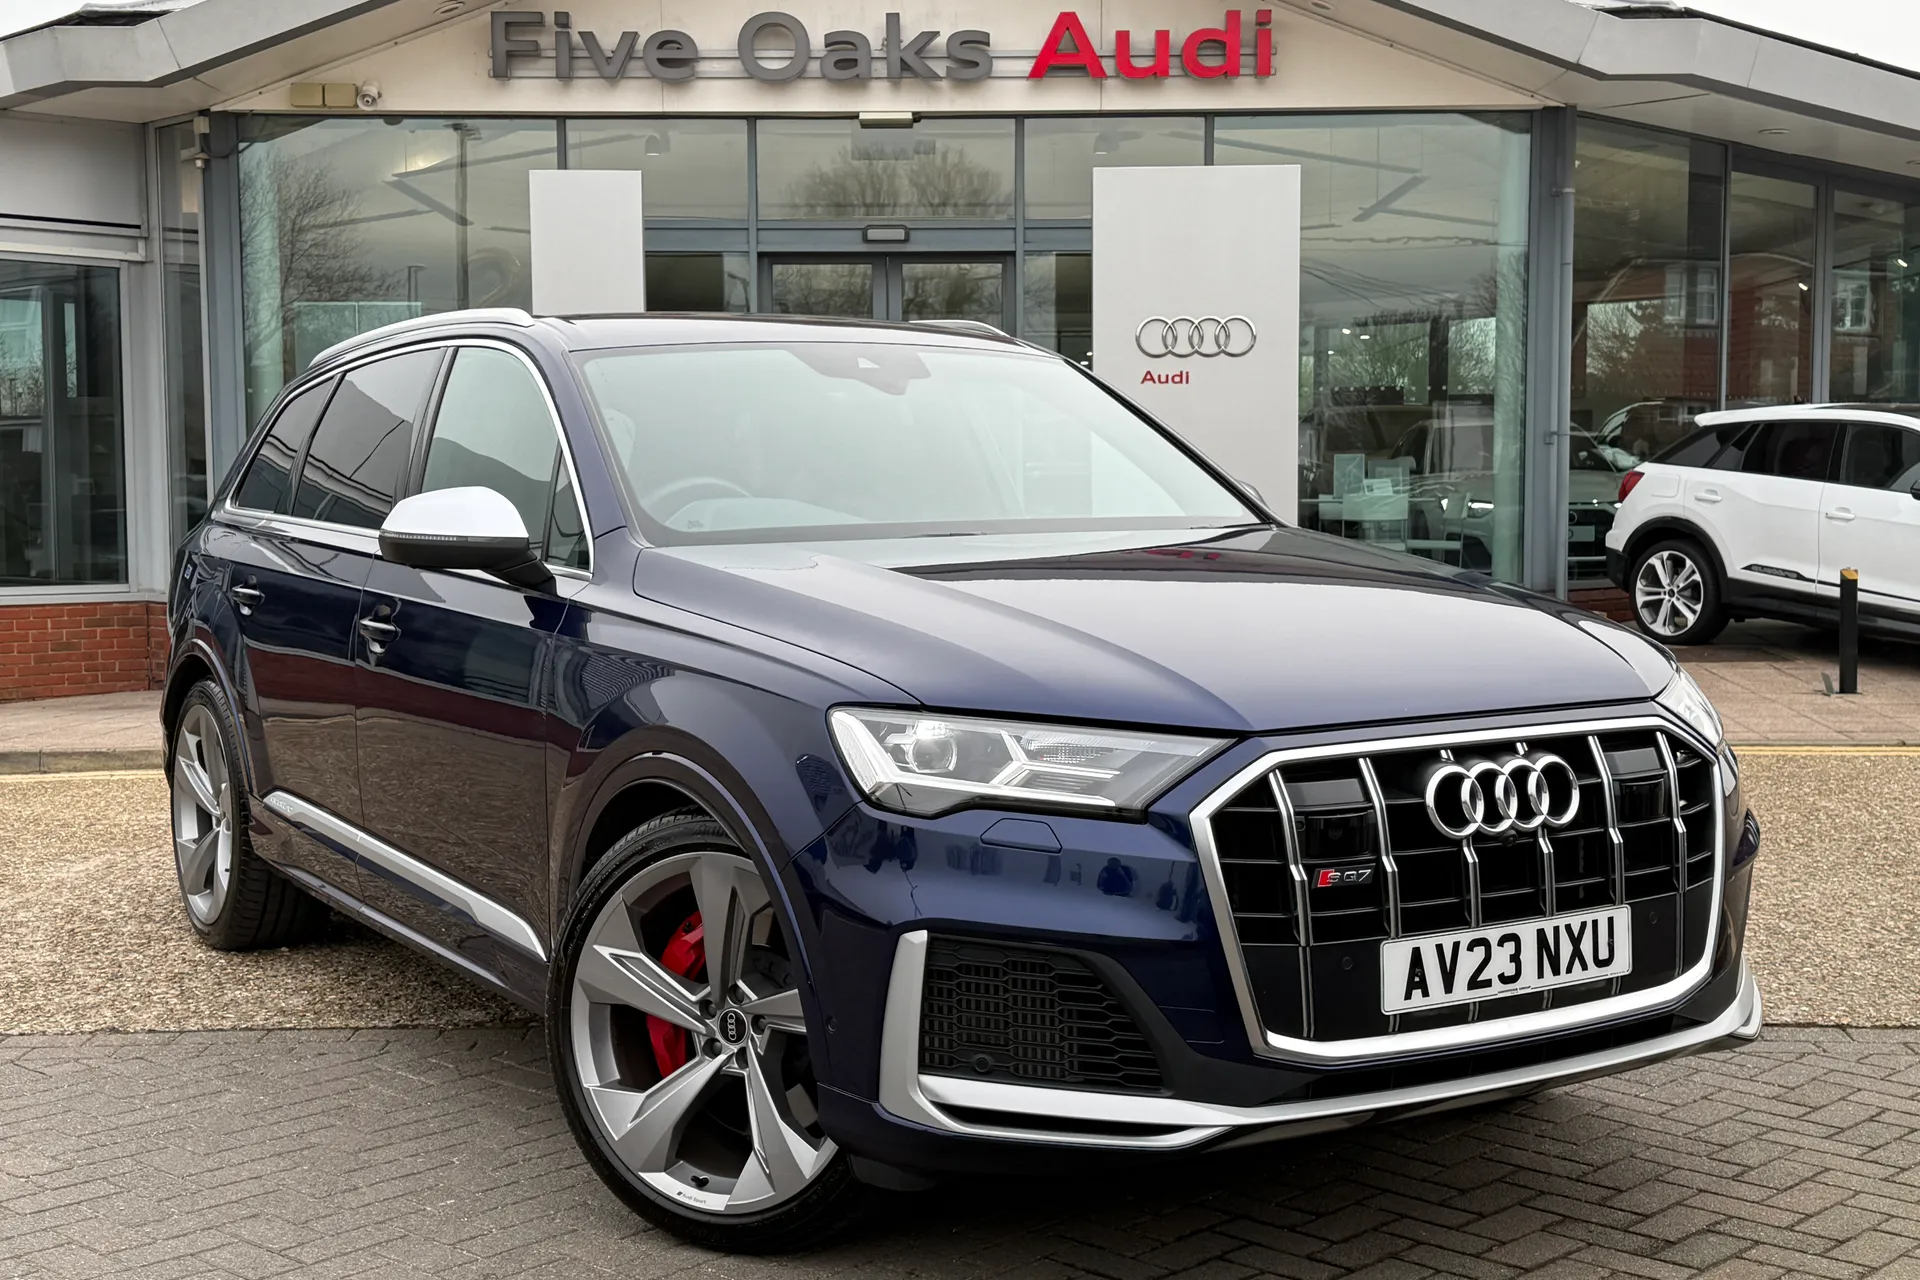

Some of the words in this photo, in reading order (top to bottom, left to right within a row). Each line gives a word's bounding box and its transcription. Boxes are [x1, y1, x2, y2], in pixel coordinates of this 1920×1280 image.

[491, 11, 697, 81] Five
[737, 12, 993, 82] Oaks
[1028, 10, 1272, 79] Audi
[1140, 370, 1190, 384] Audi
[1326, 869, 1371, 882] SQ7
[1404, 932, 1522, 1001] AV23
[1536, 916, 1614, 979] NXU
